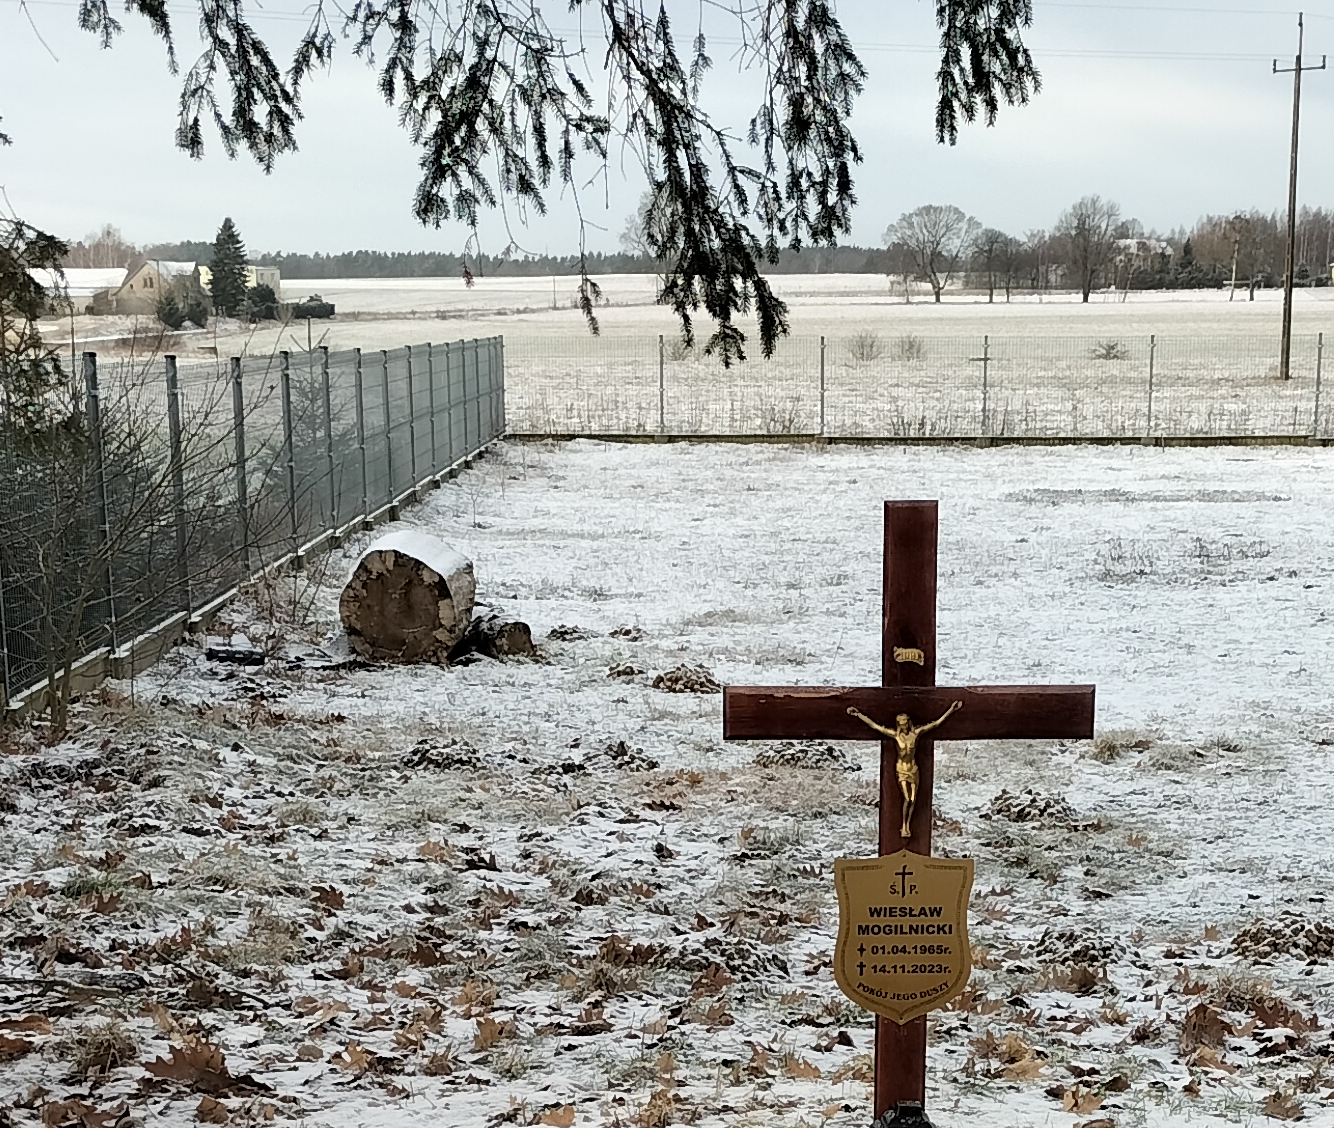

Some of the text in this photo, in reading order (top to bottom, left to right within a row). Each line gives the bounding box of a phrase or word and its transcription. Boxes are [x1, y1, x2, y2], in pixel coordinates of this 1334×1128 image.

[868, 906, 943, 918] WIESŁAW
[857, 923, 953, 936] MOGILNICKI
[870, 944, 952, 955] 01.04.1965r.
[870, 963, 952, 974] 14.11.2023r.
[856, 980, 949, 1001] POKÓJ JEGO DUSZY
